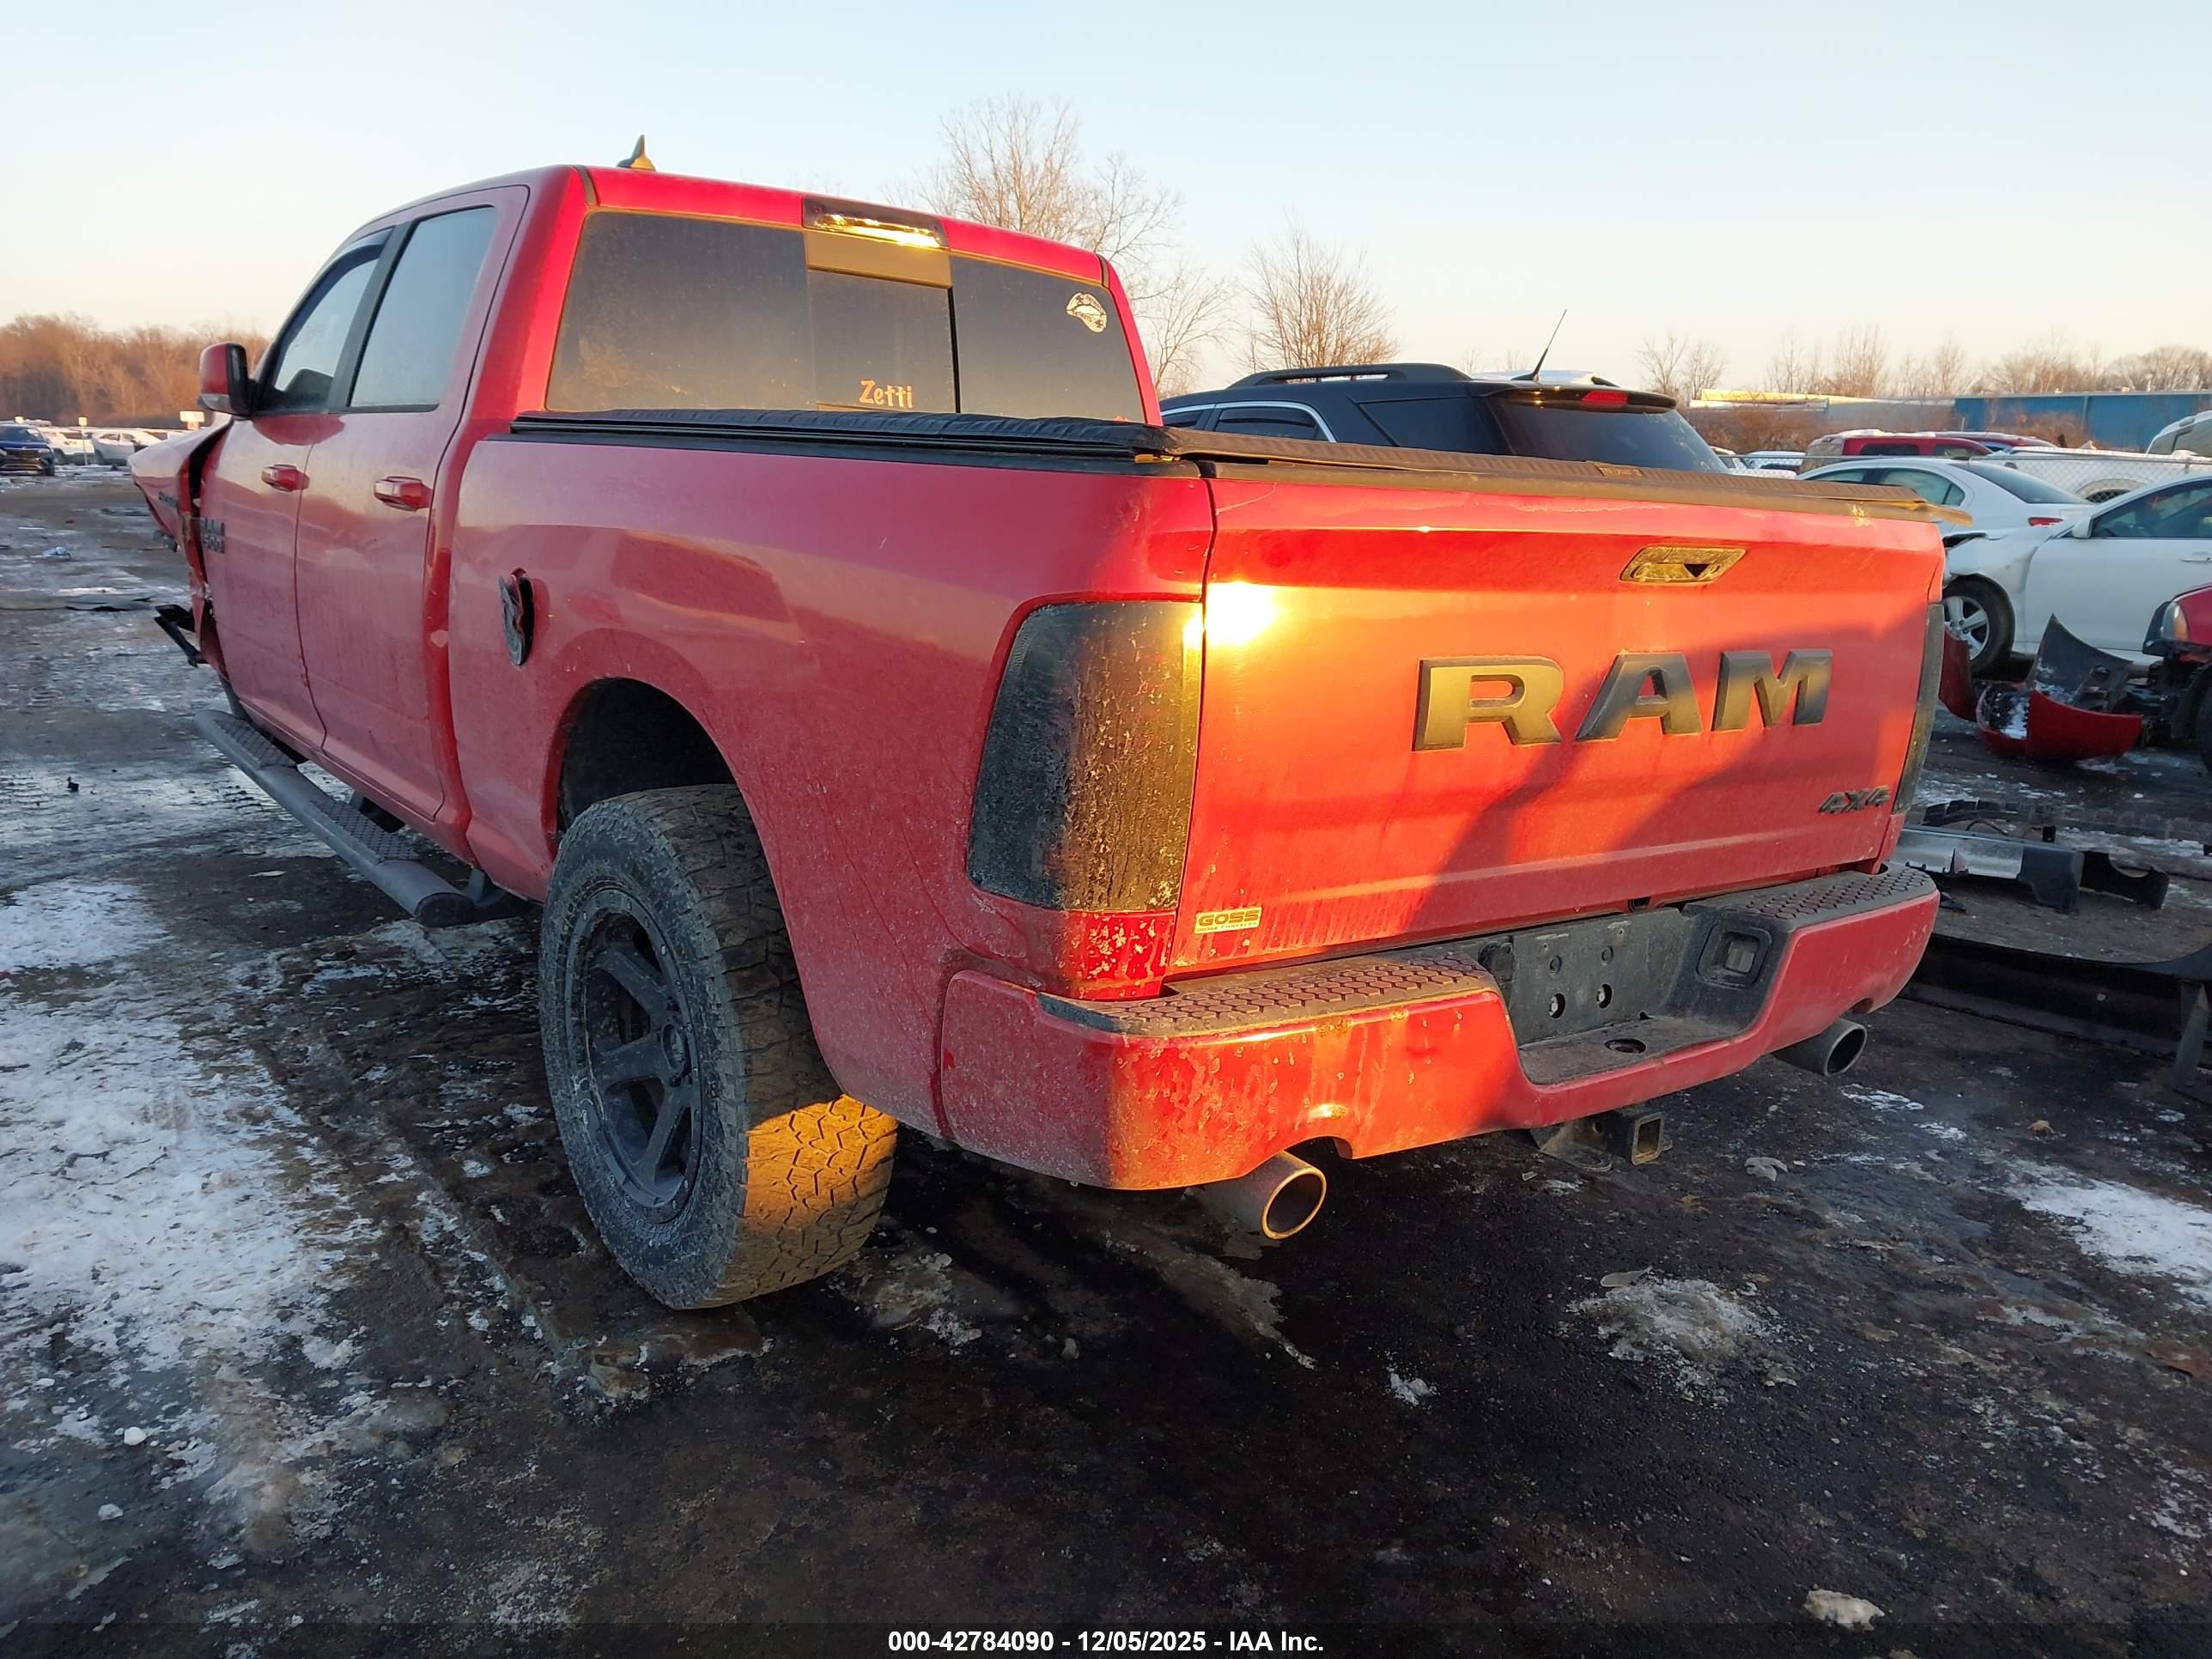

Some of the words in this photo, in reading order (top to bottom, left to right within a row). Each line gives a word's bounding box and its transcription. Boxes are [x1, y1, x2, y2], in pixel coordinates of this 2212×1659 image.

[859, 379, 913, 409] Zetti
[1411, 648, 1833, 752] RAM
[1199, 909, 1260, 927] GOSS
